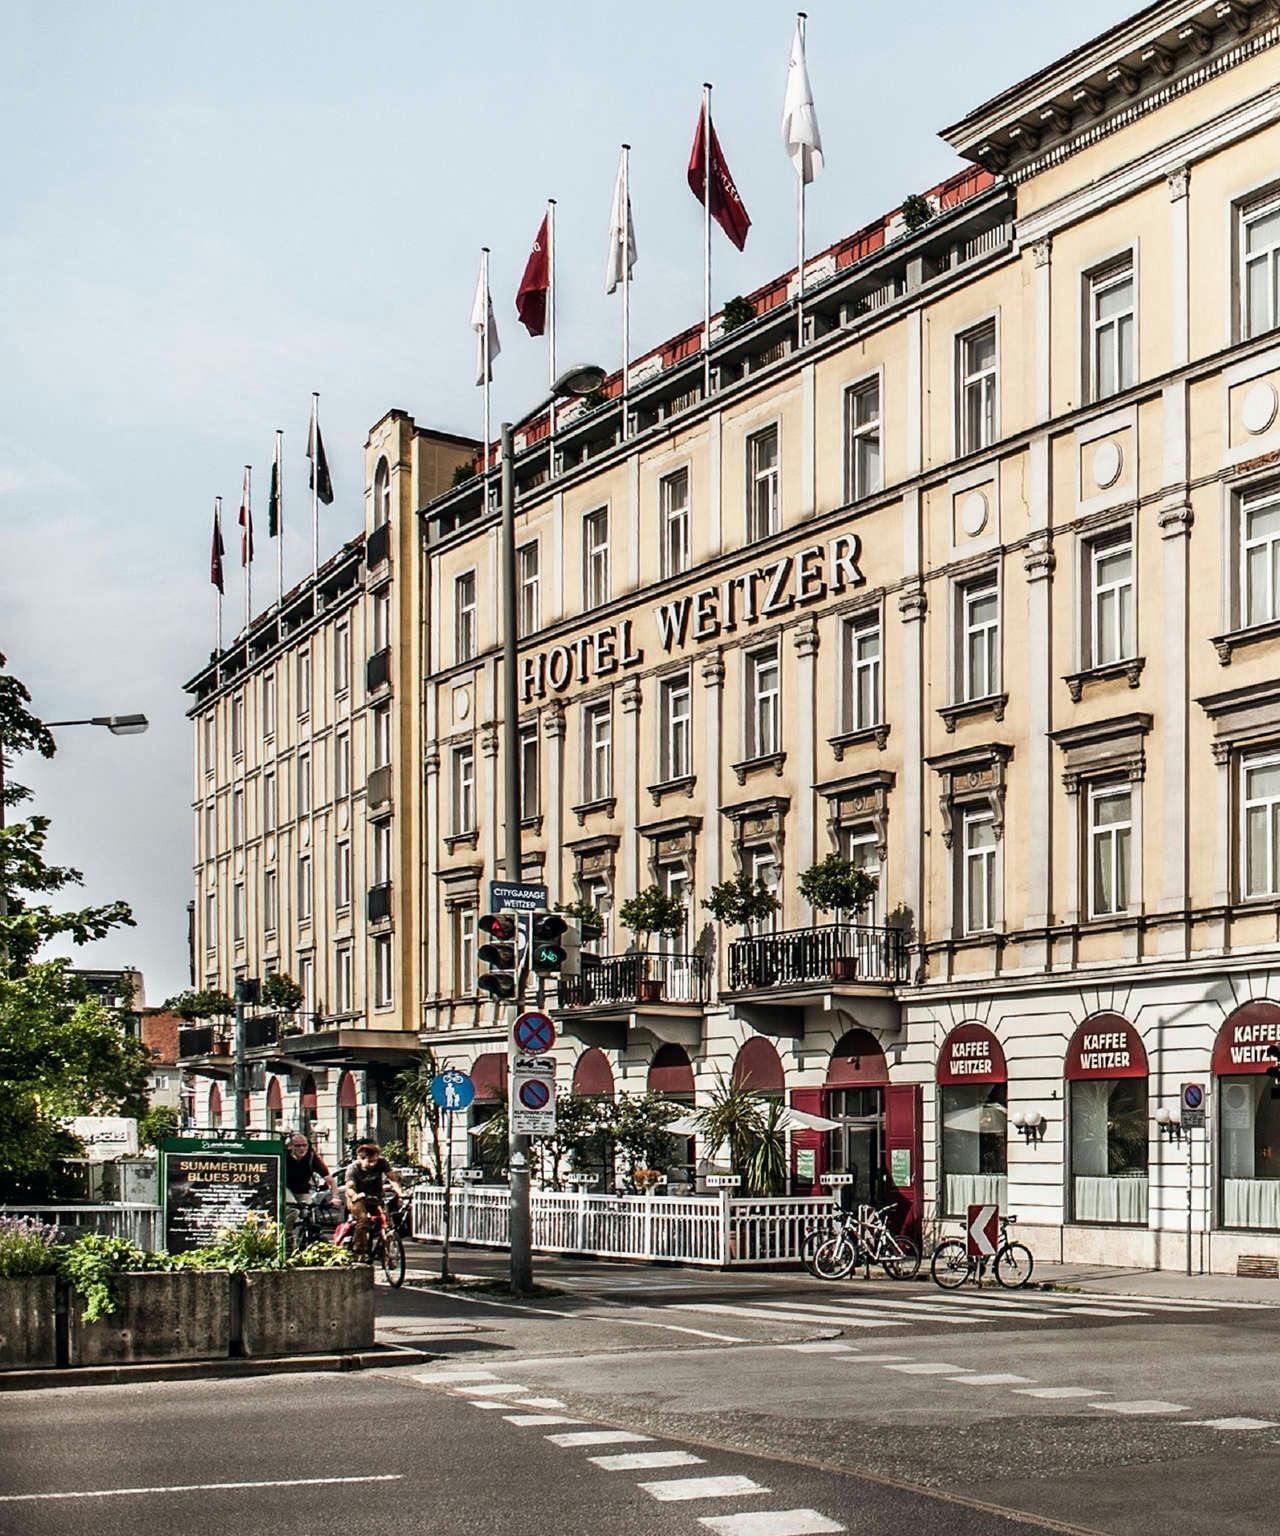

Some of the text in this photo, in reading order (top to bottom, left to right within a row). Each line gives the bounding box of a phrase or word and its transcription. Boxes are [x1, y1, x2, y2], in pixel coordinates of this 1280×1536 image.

[520, 533, 867, 701] HOTEL WEITZER
[493, 887, 545, 900] CITYGARAGE
[503, 899, 536, 908] WEITZER
[952, 1041, 989, 1057] KAFFEE
[1084, 1032, 1127, 1050] KAFFEE
[1080, 1051, 1130, 1069] WEITZER
[1230, 1045, 1279, 1063] WEITZ
[950, 1059, 992, 1075] WEITZER
[180, 1161, 268, 1173] SUMMERTIME
[187, 1172, 261, 1184] BLUES 2013
